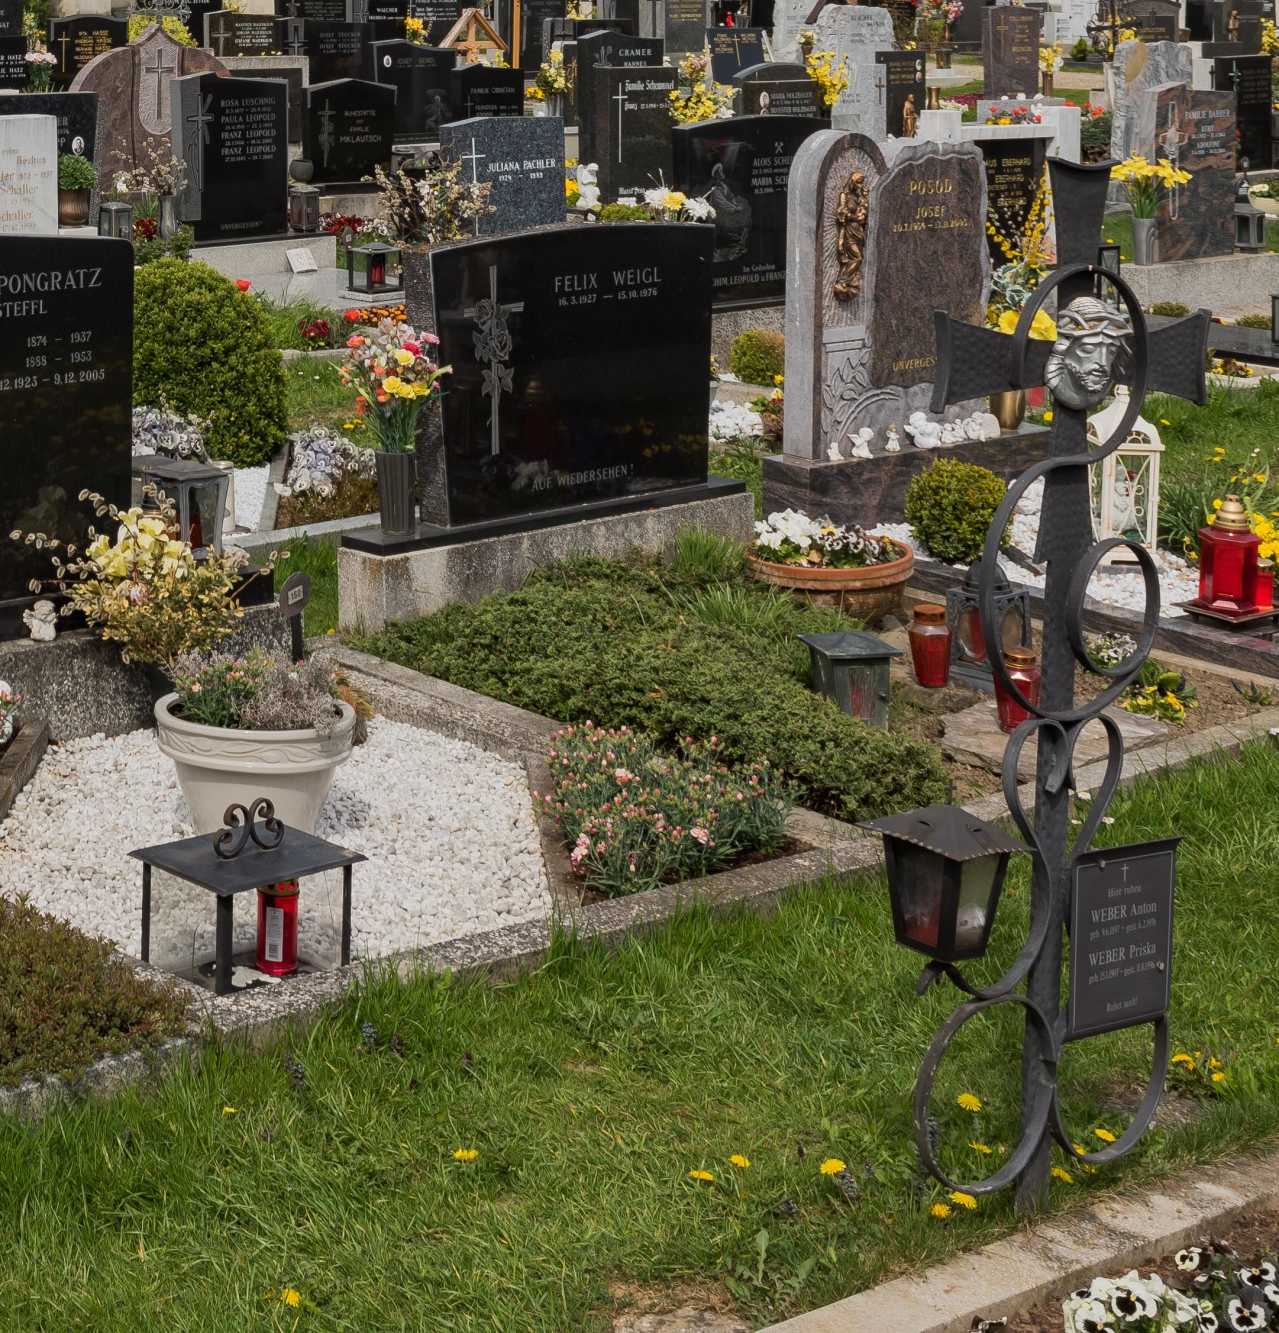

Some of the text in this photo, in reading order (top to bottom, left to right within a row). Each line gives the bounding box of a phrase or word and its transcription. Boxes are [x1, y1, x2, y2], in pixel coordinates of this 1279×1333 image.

[619, 48, 653, 57] CRAMER
[220, 97, 276, 108] ROSA LUSCHNIG
[221, 113, 276, 124] PAULA LEOPOLD
[221, 128, 277, 140] FRANZ LEOPOLD
[339, 135, 382, 144] MIKLAUTSCH
[221, 144, 277, 156] FRANZ LEOPOLD
[486, 158, 557, 173] JULIANA PACHLER
[752, 157, 772, 168] ALOIS
[751, 176, 773, 187] MARIA
[0, 183, 39, 196] Schaller
[915, 205, 946, 219] JOSEF
[554, 266, 662, 293] FELIX WEIGL
[729, 273, 760, 285] LEOPOLD
[27, 335, 49, 348] 1874
[70, 330, 92, 343] 1937
[25, 355, 47, 368] 1888
[70, 350, 92, 363] 1953
[1107, 887, 1123, 899] Hier
[1090, 901, 1158, 924] WEBER Anton
[1088, 940, 1157, 968] WEBER Priska
